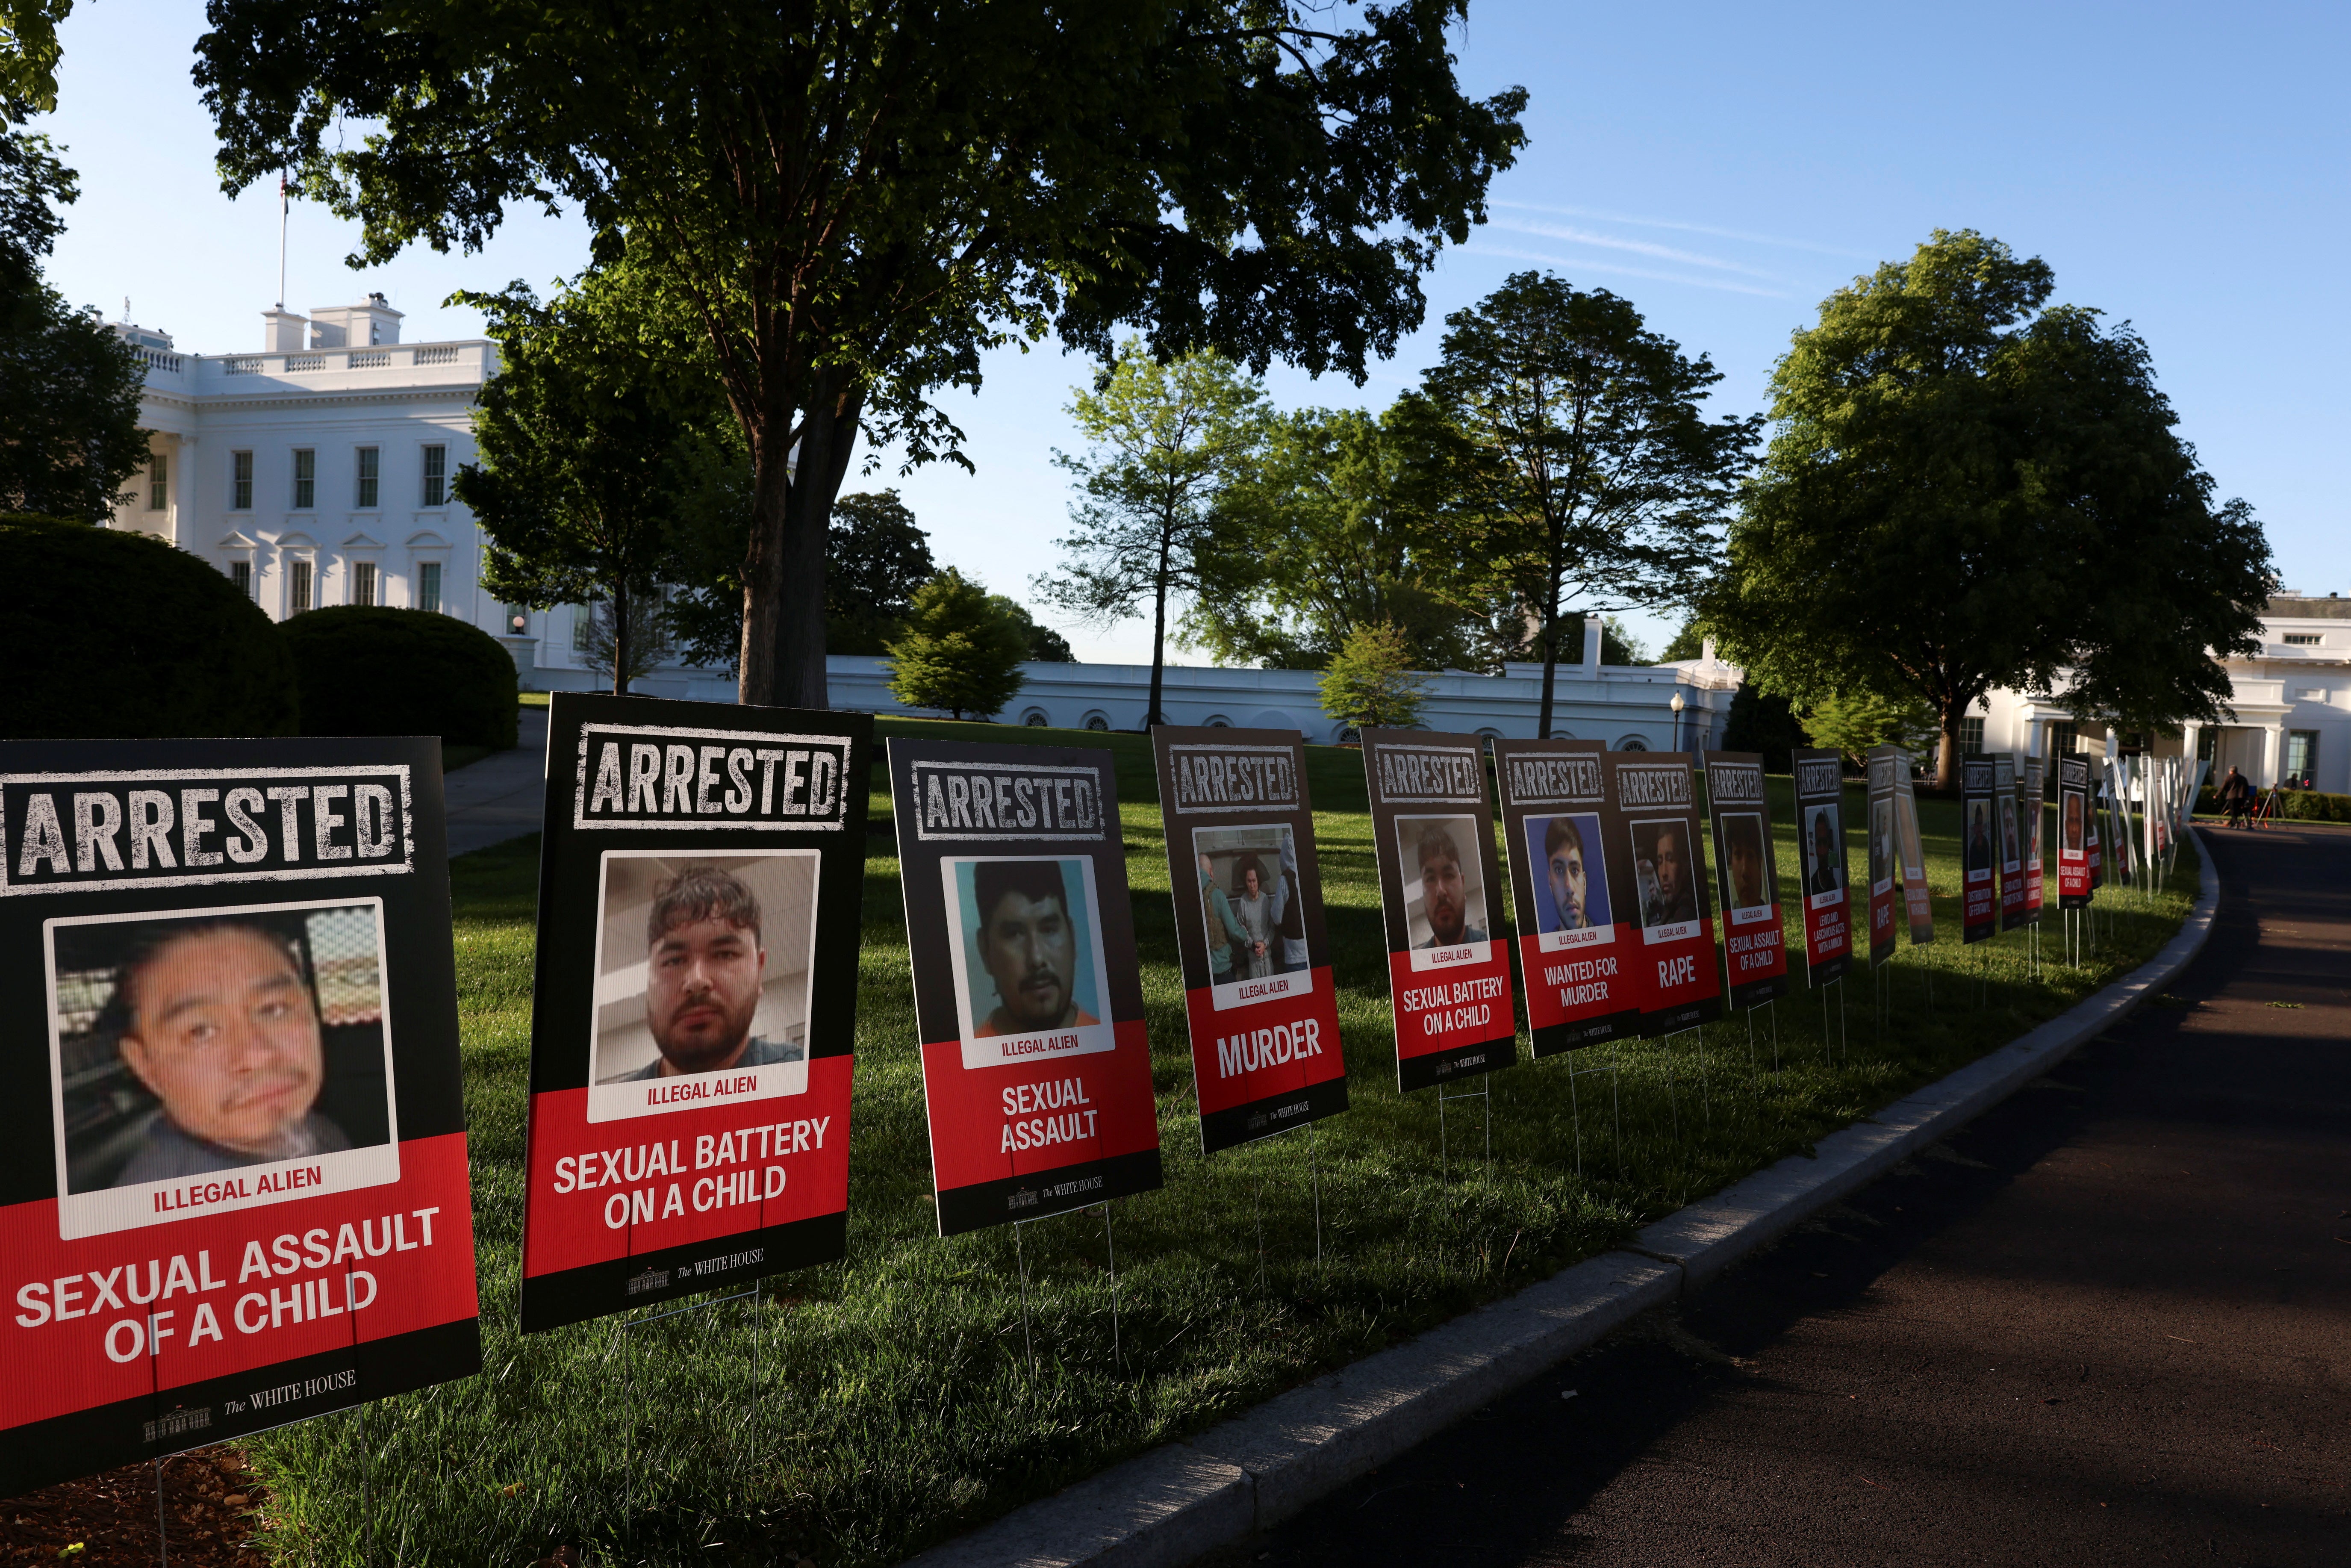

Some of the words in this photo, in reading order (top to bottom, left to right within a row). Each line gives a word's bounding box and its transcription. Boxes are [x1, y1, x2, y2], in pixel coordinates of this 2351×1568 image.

[590, 742, 837, 815] ARRESTED
[1180, 756, 1293, 802] ARRESTED
[1384, 754, 1475, 794] ARRESTED
[1514, 761, 1599, 797] ARRESTED
[1623, 771, 1687, 804] ARRESTED
[1714, 769, 1760, 798] ARRESTED
[1801, 764, 1838, 793] ARRESTED
[927, 774, 1096, 829] ARRESTED
[18, 784, 395, 875] ARRESTED
[1820, 895, 1829, 904] ILLEGAL
[1742, 911, 1753, 920] ILLEGAL
[1819, 914, 1830, 926] LEWD
[1877, 903, 1889, 930] RAPE
[1559, 934, 1581, 945] ILLEGAL
[1582, 931, 1597, 942] ALIEN
[1658, 928, 1674, 938] ILLEGAL
[1675, 926, 1687, 935] ALIEN
[1730, 935, 1753, 953] SEXUAL
[1754, 930, 1779, 949] ASSAULT
[1814, 925, 1835, 942] LASCIVIOUS
[1835, 922, 1844, 934] ACTS
[1818, 941, 1828, 954] WITH
[1828, 940, 1831, 950] A
[1831, 936, 1842, 949] MINOR
[1432, 950, 1455, 963] ILLEGAL
[1456, 949, 1472, 960] ALIEN
[1740, 954, 1748, 971] OF
[1750, 954, 1754, 969] A
[1755, 950, 1773, 967] CHILD
[1544, 961, 1594, 986] WANTED
[1596, 957, 1618, 977] FOR
[1658, 955, 1696, 988] RAPE
[1239, 983, 1268, 999] ILLEGAL
[1270, 979, 1289, 993] ALIEN
[1403, 984, 1452, 1012] SEXUAL
[1453, 976, 1503, 1004] BATTERY
[1561, 981, 1609, 1007] MURDER
[1424, 1012, 1443, 1035] ON
[1445, 1011, 1454, 1032] A
[1455, 1004, 1490, 1029] CHILD
[1588, 1026, 1600, 1037] WHITE
[1600, 1025, 1612, 1035] HOUSE
[1002, 1039, 1046, 1057] ILLEGAL
[1048, 1035, 1078, 1051] ALIEN
[1217, 1018, 1323, 1079] MURDER
[1460, 1057, 1473, 1068] WHITE
[1473, 1054, 1485, 1065] HOUSE
[648, 1082, 710, 1106] ILLEGAL
[714, 1075, 757, 1096] ALIEN
[1002, 1077, 1090, 1116] SEXUAL
[1277, 1106, 1293, 1118] WHITE
[1293, 1101, 1310, 1113] HOUSE
[1001, 1109, 1097, 1154] ASSAULT
[553, 1139, 687, 1194] SEXUAL
[695, 1116, 831, 1170] BATTERY
[154, 1179, 251, 1212] ILLEGAL
[256, 1166, 322, 1196] ALIEN
[604, 1188, 654, 1230] ON
[662, 1183, 684, 1220] A
[692, 1165, 787, 1213] CHILD
[1043, 1188, 1053, 1198] The
[1054, 1181, 1078, 1197] WHITE
[1078, 1176, 1103, 1191] HOUSE
[15, 1250, 226, 1328] SEXUAL
[238, 1206, 440, 1283] ASSAULT
[678, 1266, 692, 1279] The
[694, 1253, 728, 1276] WHITE
[730, 1248, 763, 1268] HOUSE
[104, 1311, 174, 1364] OF
[189, 1303, 224, 1347] A
[234, 1270, 377, 1334] CHILD
[224, 1399, 246, 1415] The
[250, 1383, 301, 1411] WHITE
[305, 1370, 356, 1397] HOUSE
